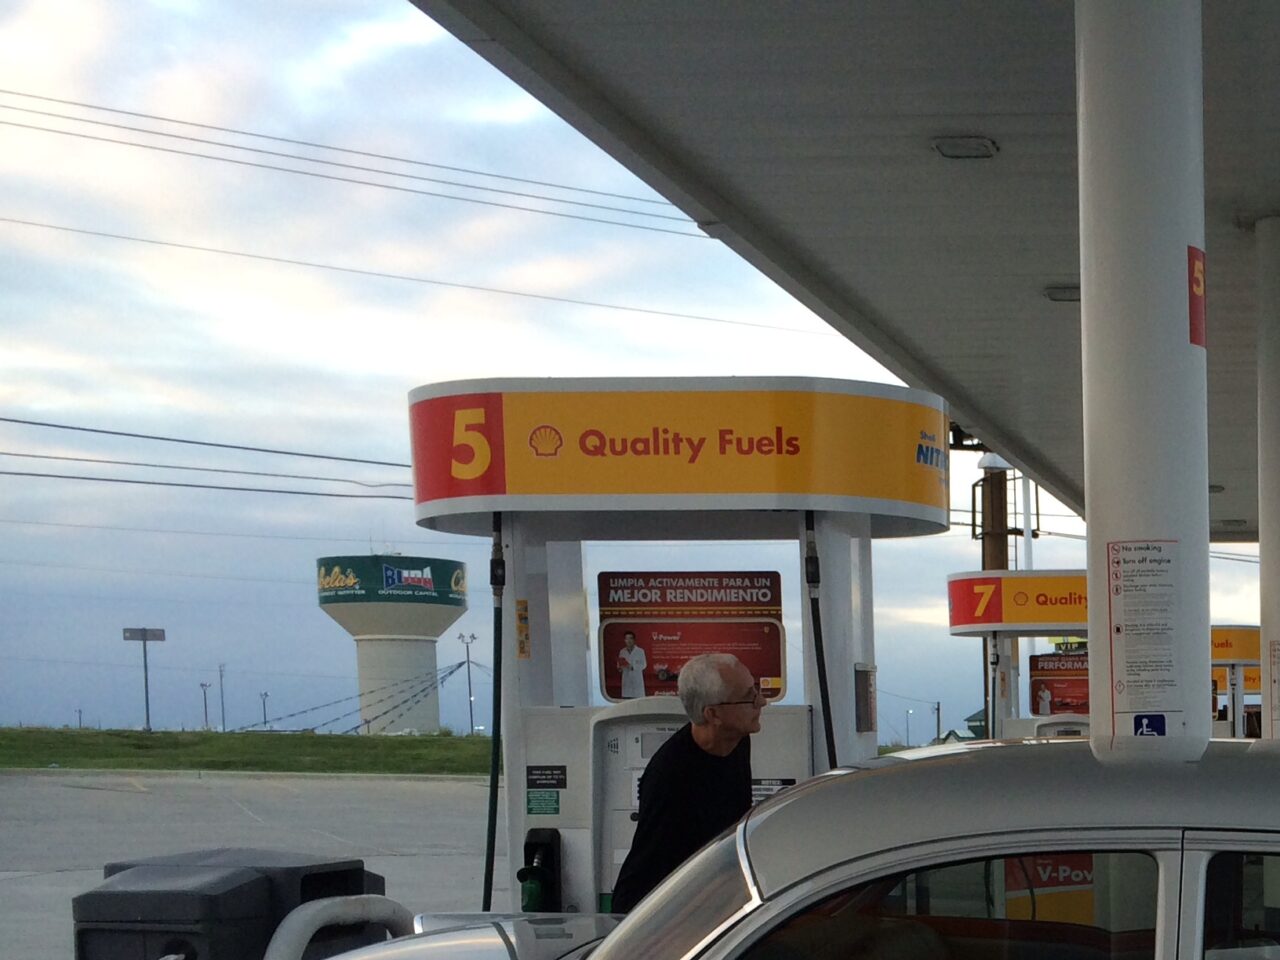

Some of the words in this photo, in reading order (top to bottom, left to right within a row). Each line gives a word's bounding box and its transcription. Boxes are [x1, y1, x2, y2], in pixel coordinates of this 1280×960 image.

[1193, 260, 1205, 296] 5
[451, 408, 491, 480] 5
[578, 427, 706, 463] Quality
[718, 426, 800, 456] Fuels
[1133, 544, 1162, 553] smoking
[1137, 556, 1147, 564] off
[1149, 556, 1171, 566] engine
[383, 563, 434, 591] BUDA
[609, 577, 645, 588] LIMPIA
[649, 577, 719, 588] ACTIVAMENTE
[722, 577, 751, 588] PARA
[754, 577, 771, 587] UN
[609, 589, 662, 603] MEJOR
[666, 588, 772, 602] RENDIMIENTO
[973, 584, 996, 617] 7
[1212, 639, 1233, 649] uels
